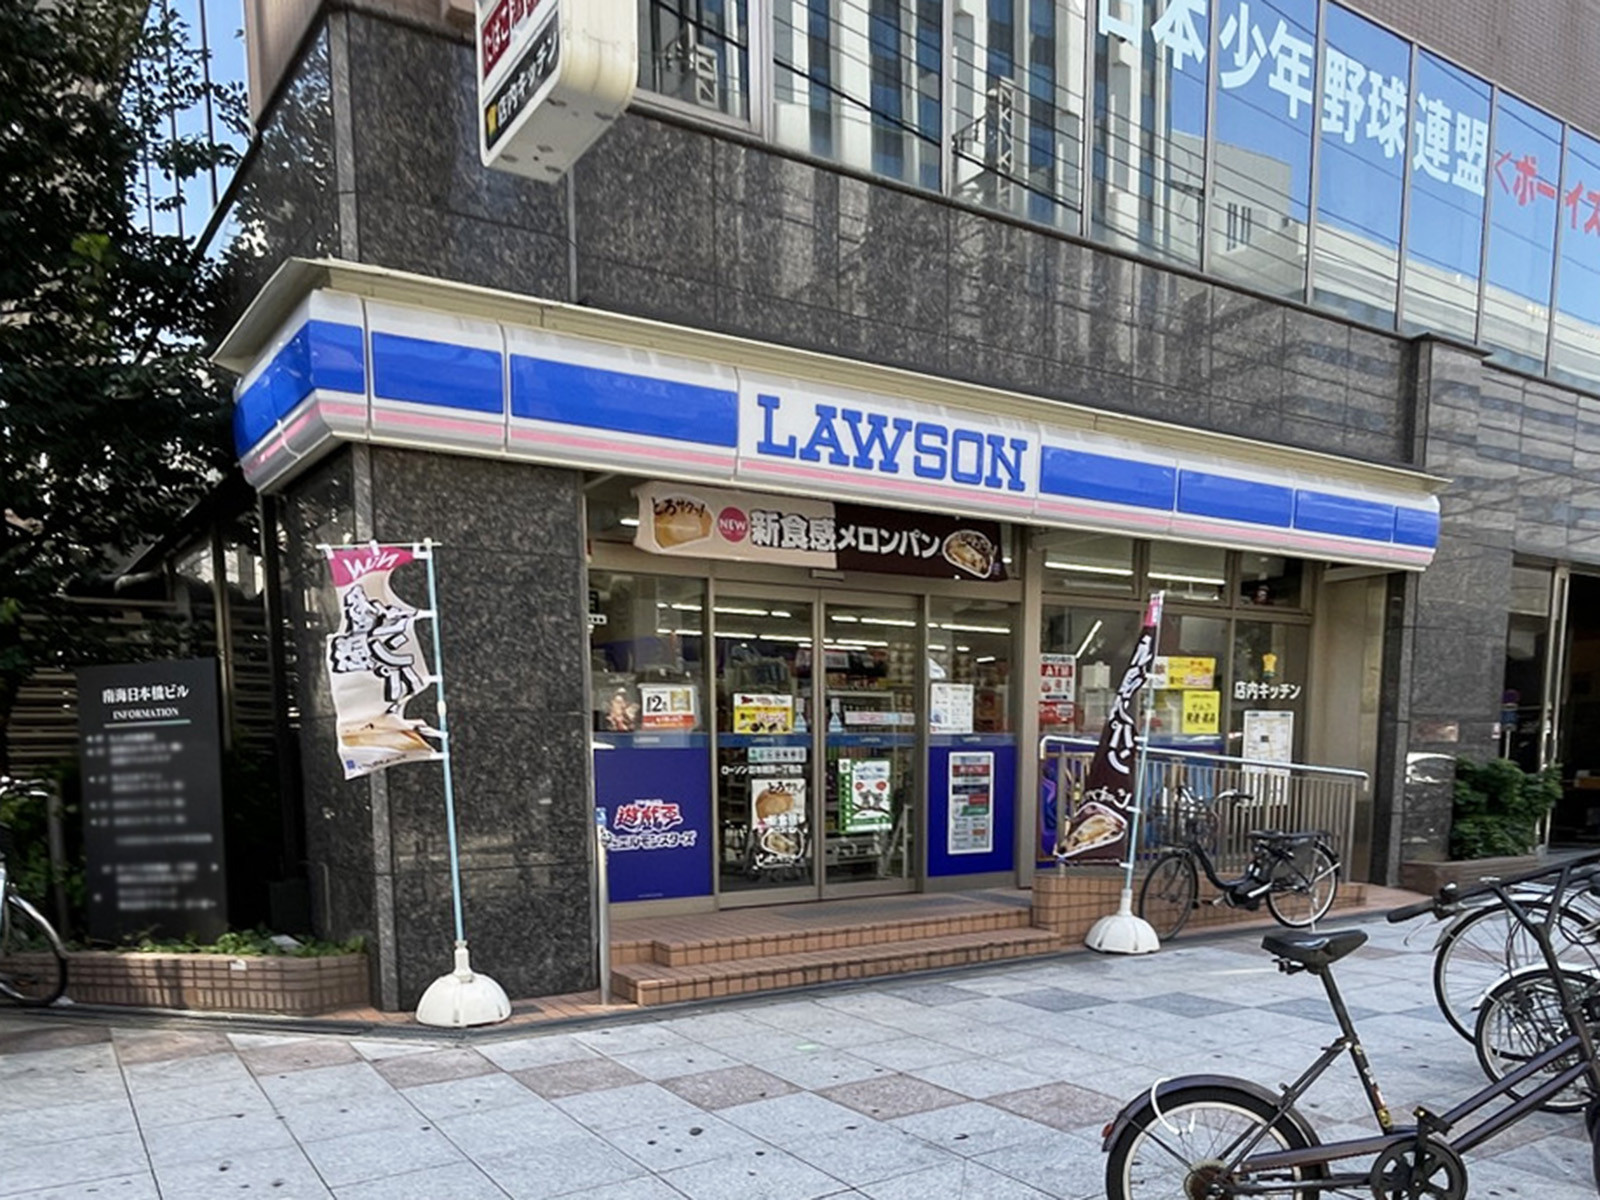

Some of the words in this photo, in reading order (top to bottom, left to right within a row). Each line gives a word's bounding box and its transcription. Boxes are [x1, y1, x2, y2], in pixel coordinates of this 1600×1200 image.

[757, 394, 1028, 492] LAWSON
[719, 518, 748, 532] NEW
[102, 684, 189, 704] 南海日本橋ビル
[1234, 681, 1302, 700] 店内キッチン
[112, 707, 179, 719] INFORMATION
